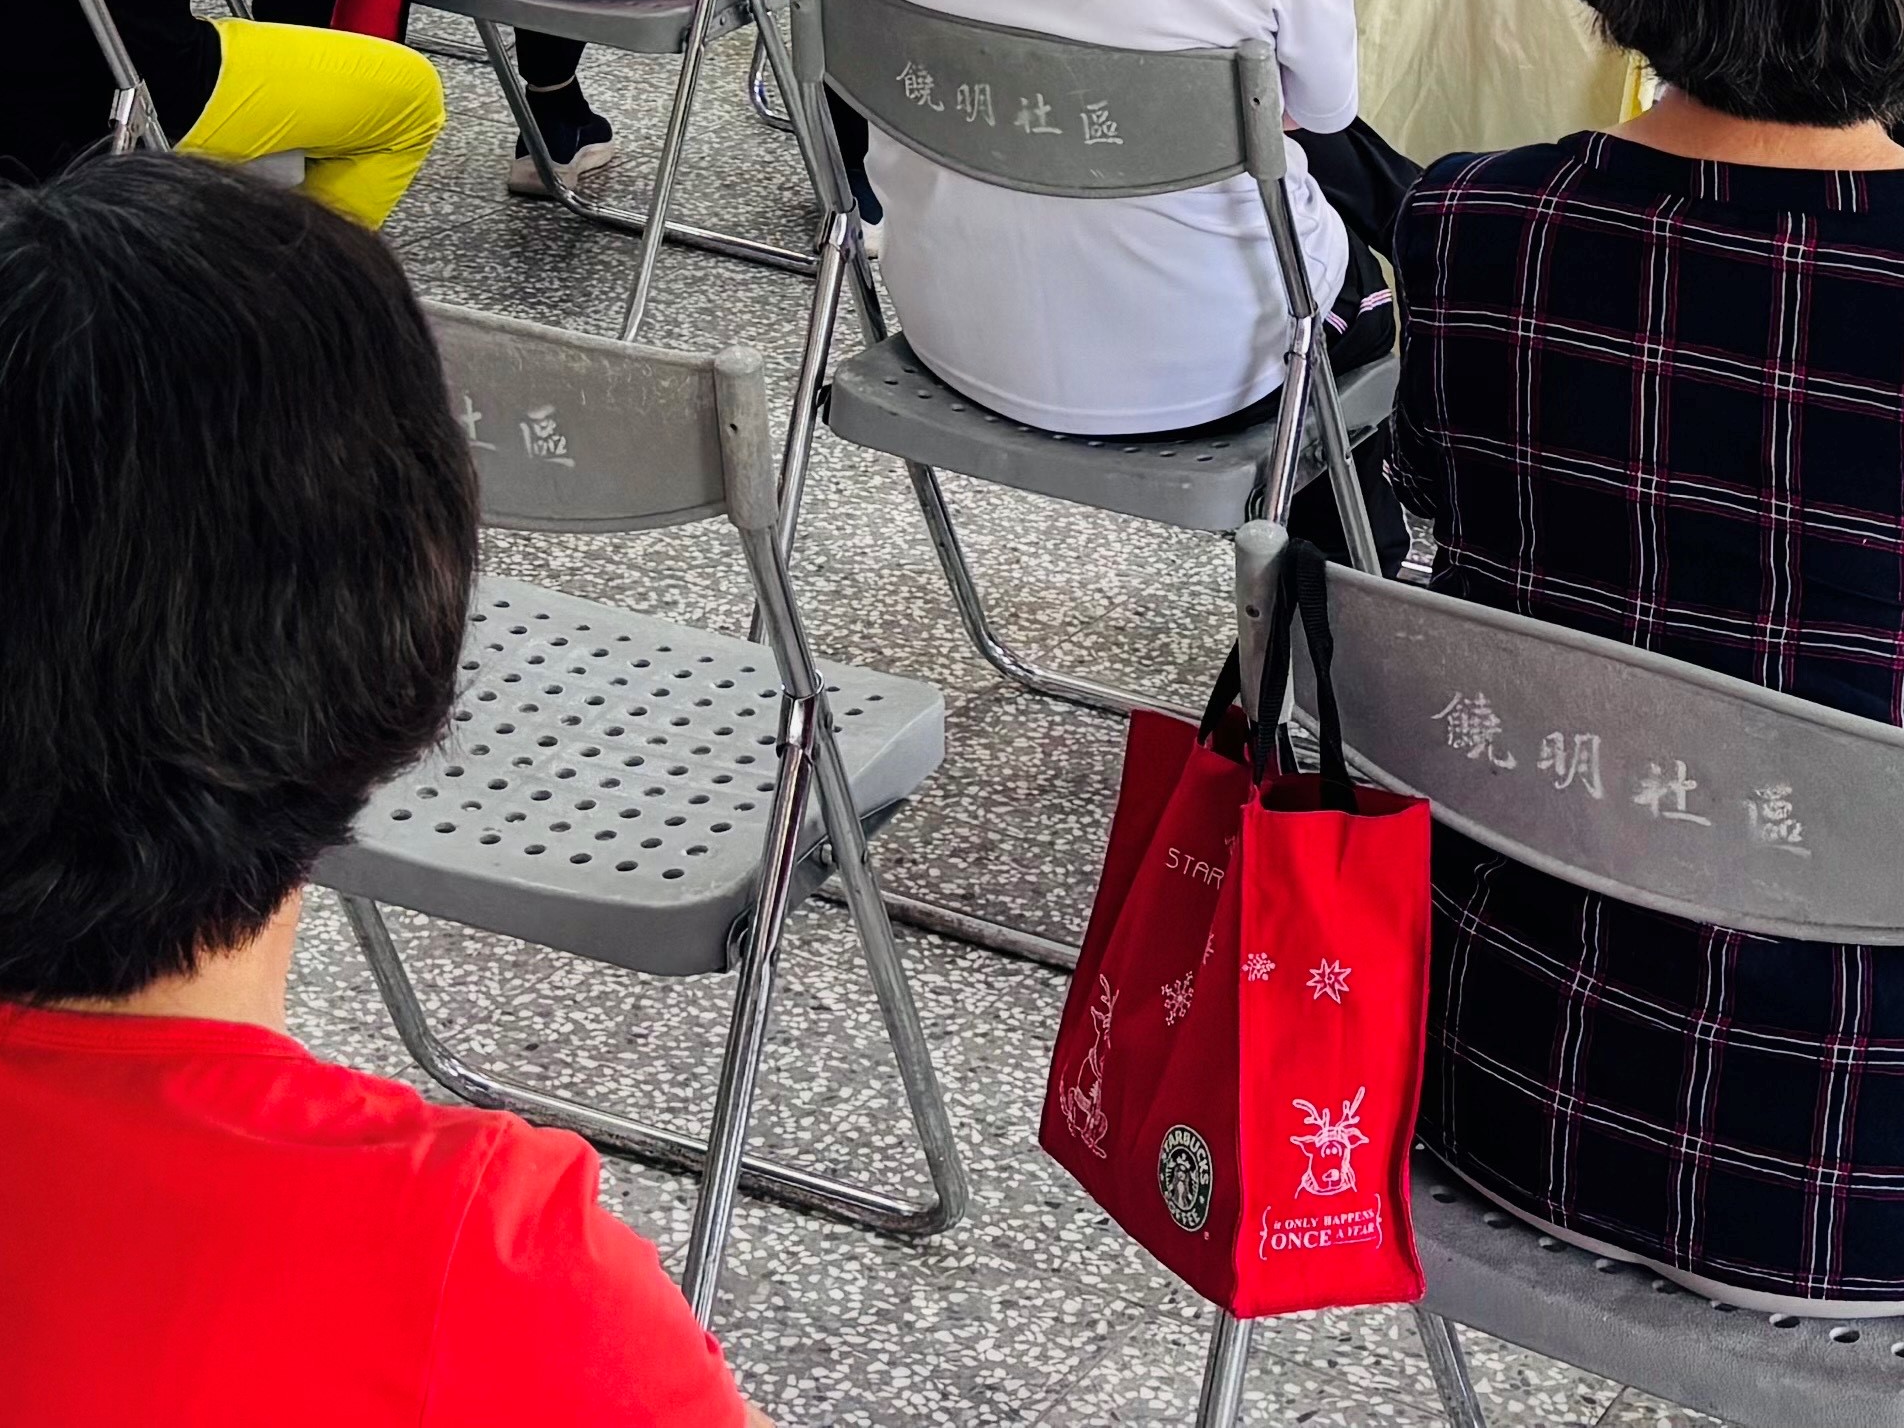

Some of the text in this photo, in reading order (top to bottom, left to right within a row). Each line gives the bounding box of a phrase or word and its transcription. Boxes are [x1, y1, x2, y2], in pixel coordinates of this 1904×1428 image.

[895, 60, 1124, 146] 饒明社區
[1284, 1217, 1320, 1230] ONLY
[1324, 1209, 1375, 1227] HAPPENS
[1271, 1230, 1332, 1250] ONCE
[1348, 1223, 1375, 1237] YEAR
